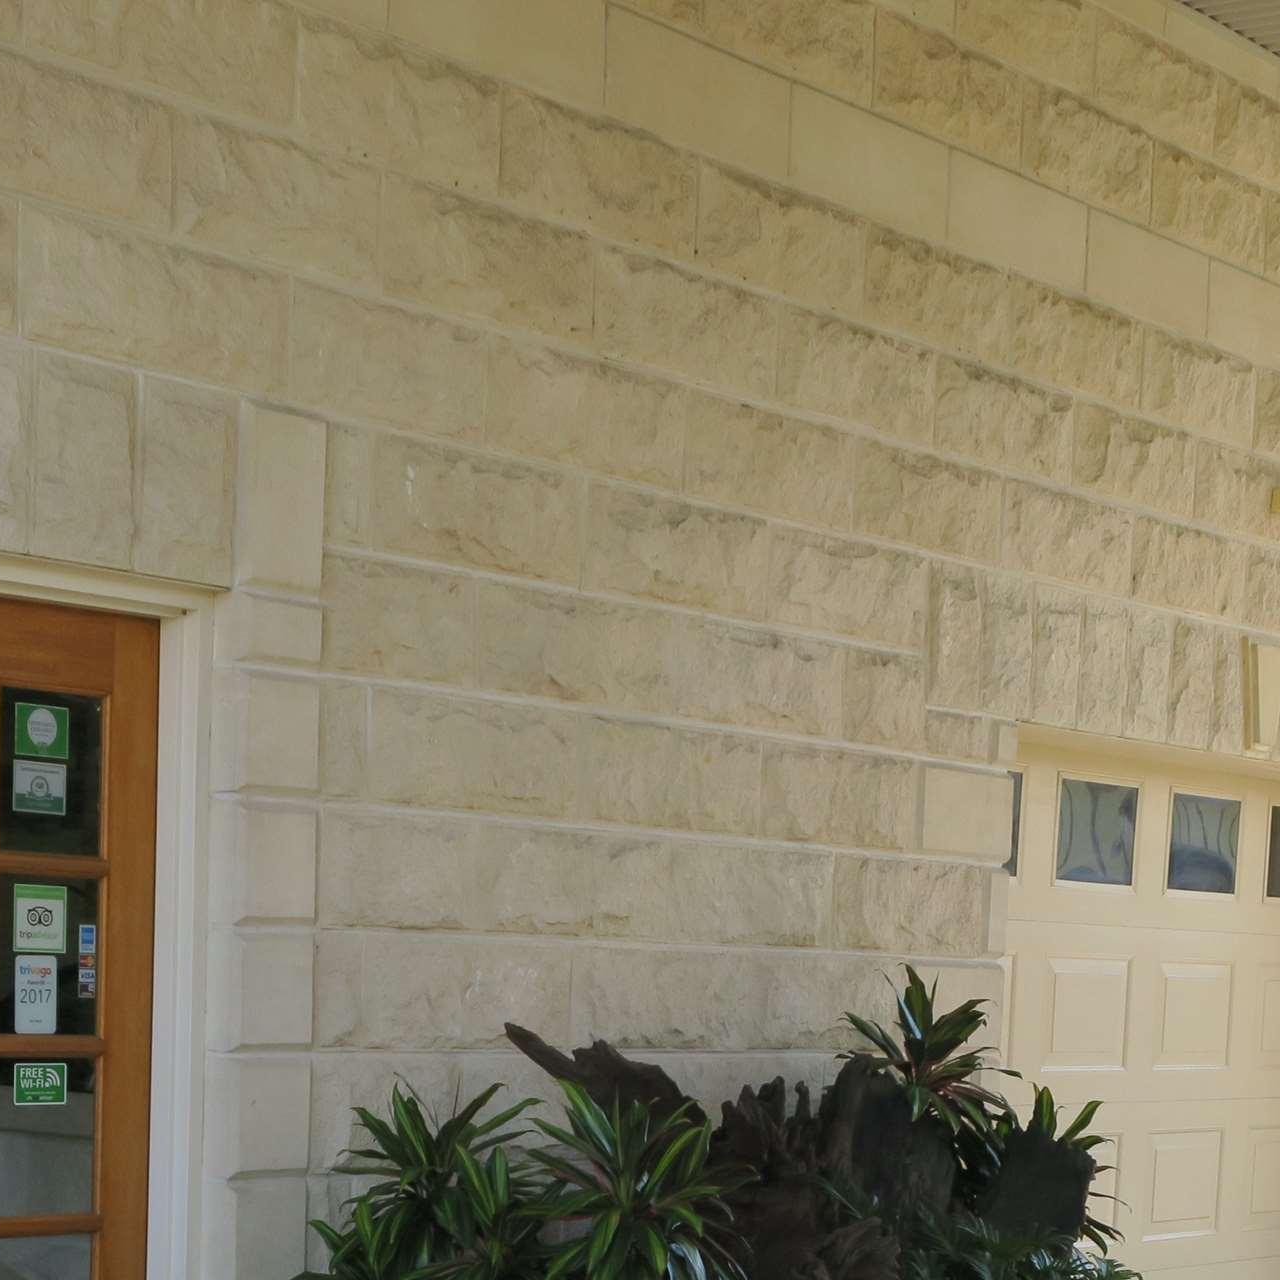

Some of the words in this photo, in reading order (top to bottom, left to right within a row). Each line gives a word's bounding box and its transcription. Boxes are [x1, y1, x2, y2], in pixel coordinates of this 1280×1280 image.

[19, 988, 52, 1004] 2017
[20, 1067, 44, 1079] FREE
[20, 1078, 45, 1088] WI-FI
